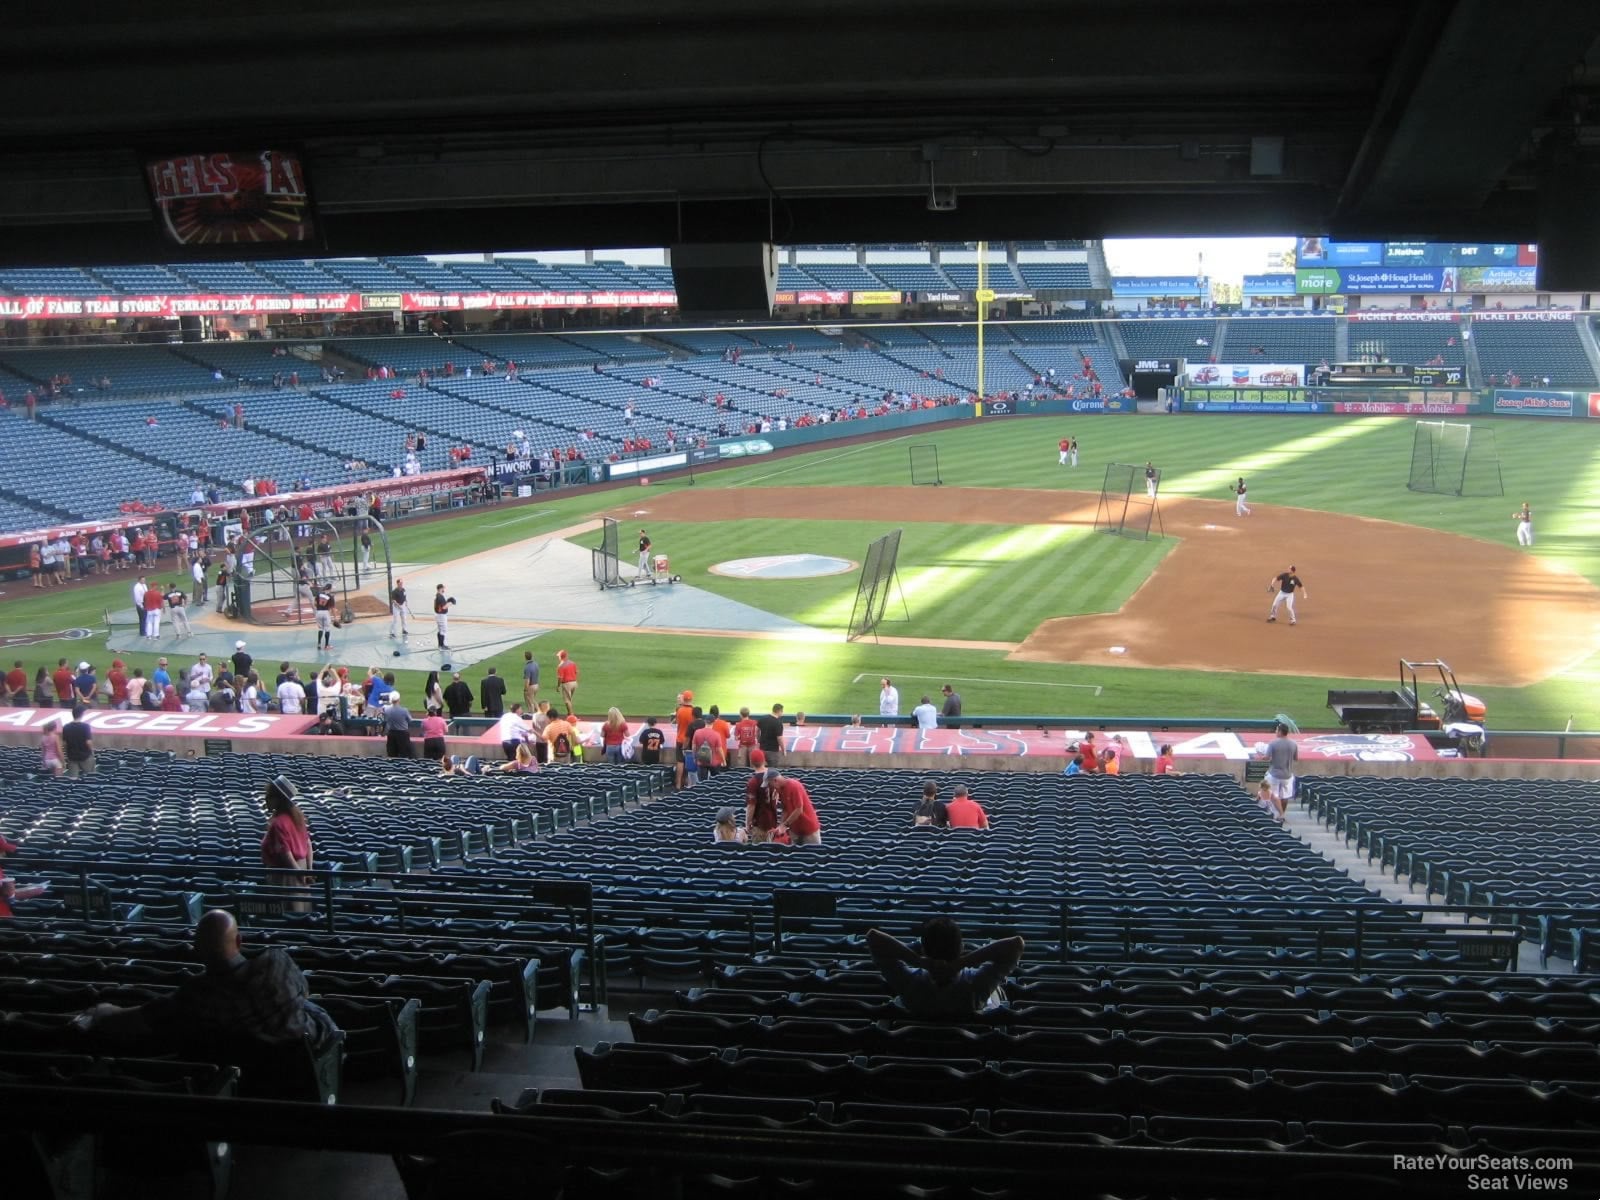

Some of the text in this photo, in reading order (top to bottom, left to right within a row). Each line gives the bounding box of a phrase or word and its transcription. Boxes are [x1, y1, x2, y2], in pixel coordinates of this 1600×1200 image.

[1409, 273, 1434, 282] Health
[927, 293, 961, 301] Yard House
[28, 300, 44, 314] OF
[47, 300, 82, 314] FAME
[86, 300, 119, 313] TEAM
[122, 299, 161, 313] STORE
[171, 299, 219, 313] TERRACE
[222, 299, 255, 311] LEVEL
[256, 298, 291, 310] BEHIND
[293, 298, 317, 310] HOME
[319, 298, 346, 309] PLATE
[1357, 312, 1394, 321] TICKET
[1475, 312, 1513, 320] TICKET
[1135, 360, 1159, 369] JMG
[1072, 399, 1105, 411] Corona
[487, 460, 532, 477] NETWORK
[648, 739, 660, 750] 27
